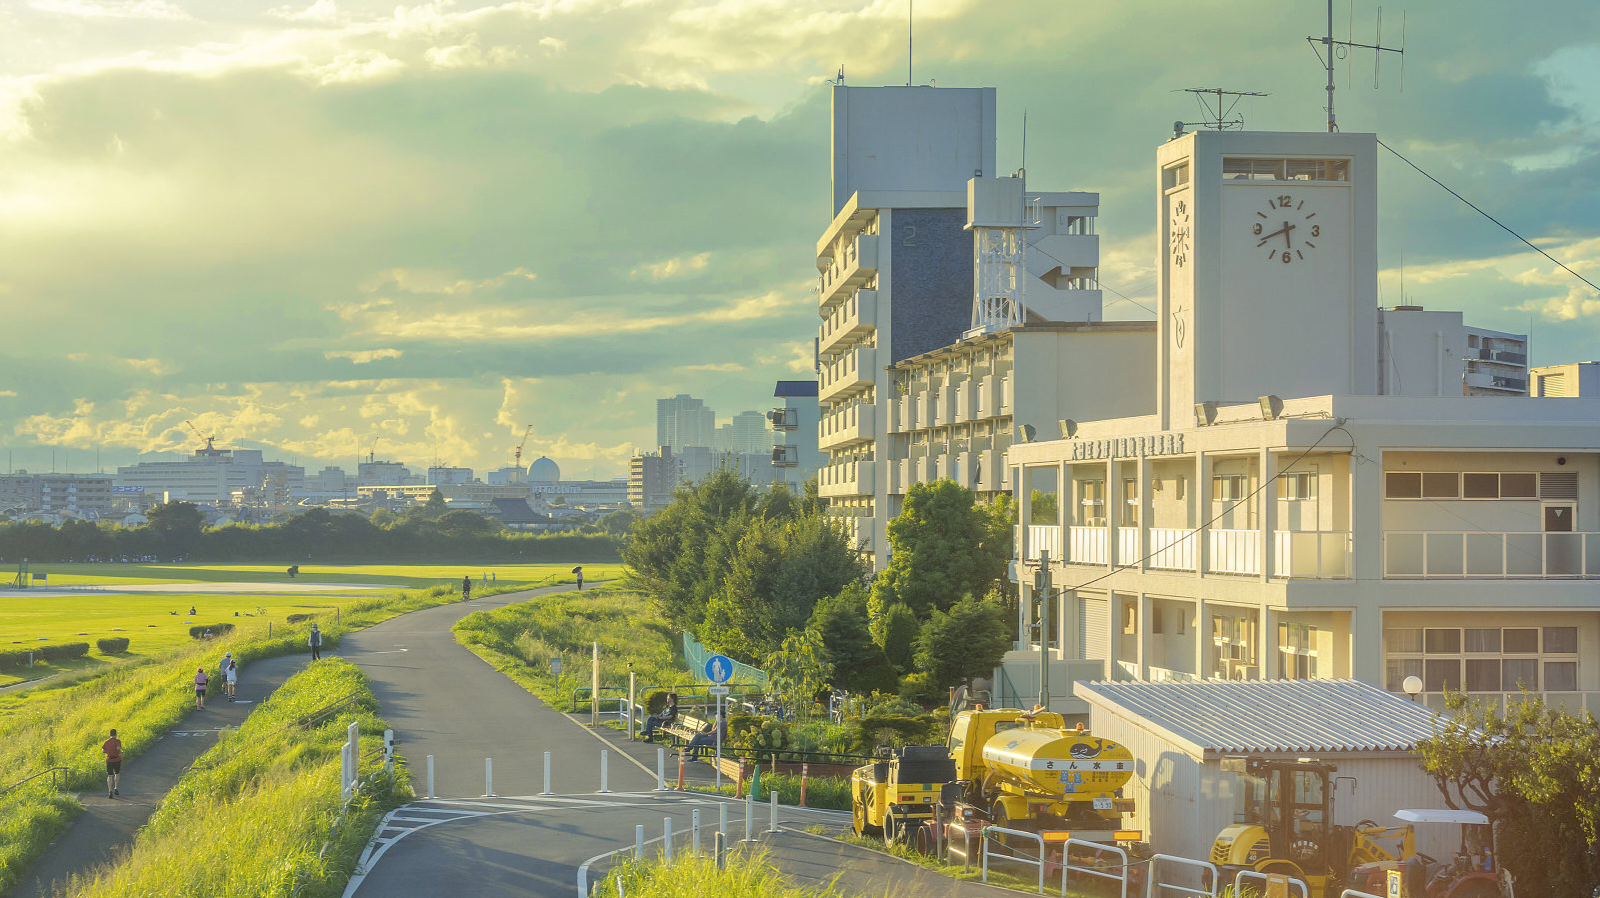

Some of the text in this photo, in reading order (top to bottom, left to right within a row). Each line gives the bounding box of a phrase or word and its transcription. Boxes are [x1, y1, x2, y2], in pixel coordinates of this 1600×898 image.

[1277, 195, 1292, 208] 12
[1253, 223, 1262, 235] 9
[1311, 225, 1320, 237] 3
[903, 225, 916, 247] 2
[1282, 251, 1291, 263] 6
